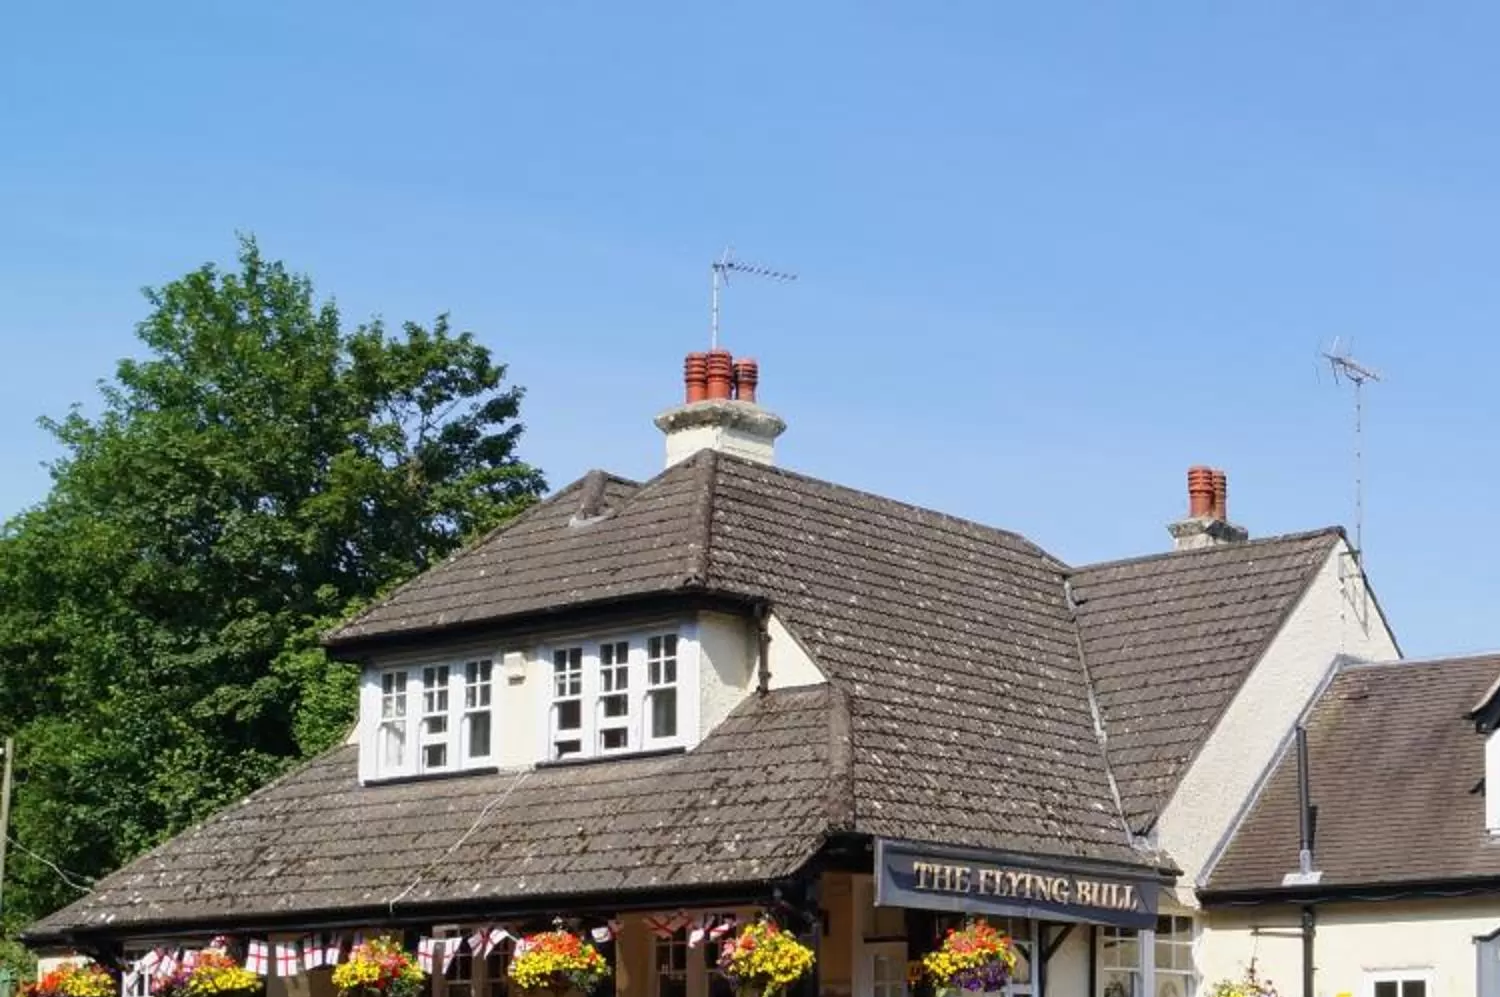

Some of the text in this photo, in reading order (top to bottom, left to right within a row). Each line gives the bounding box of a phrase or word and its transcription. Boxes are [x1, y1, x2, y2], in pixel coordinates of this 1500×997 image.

[913, 861, 1139, 912] THE FLYING BULL
